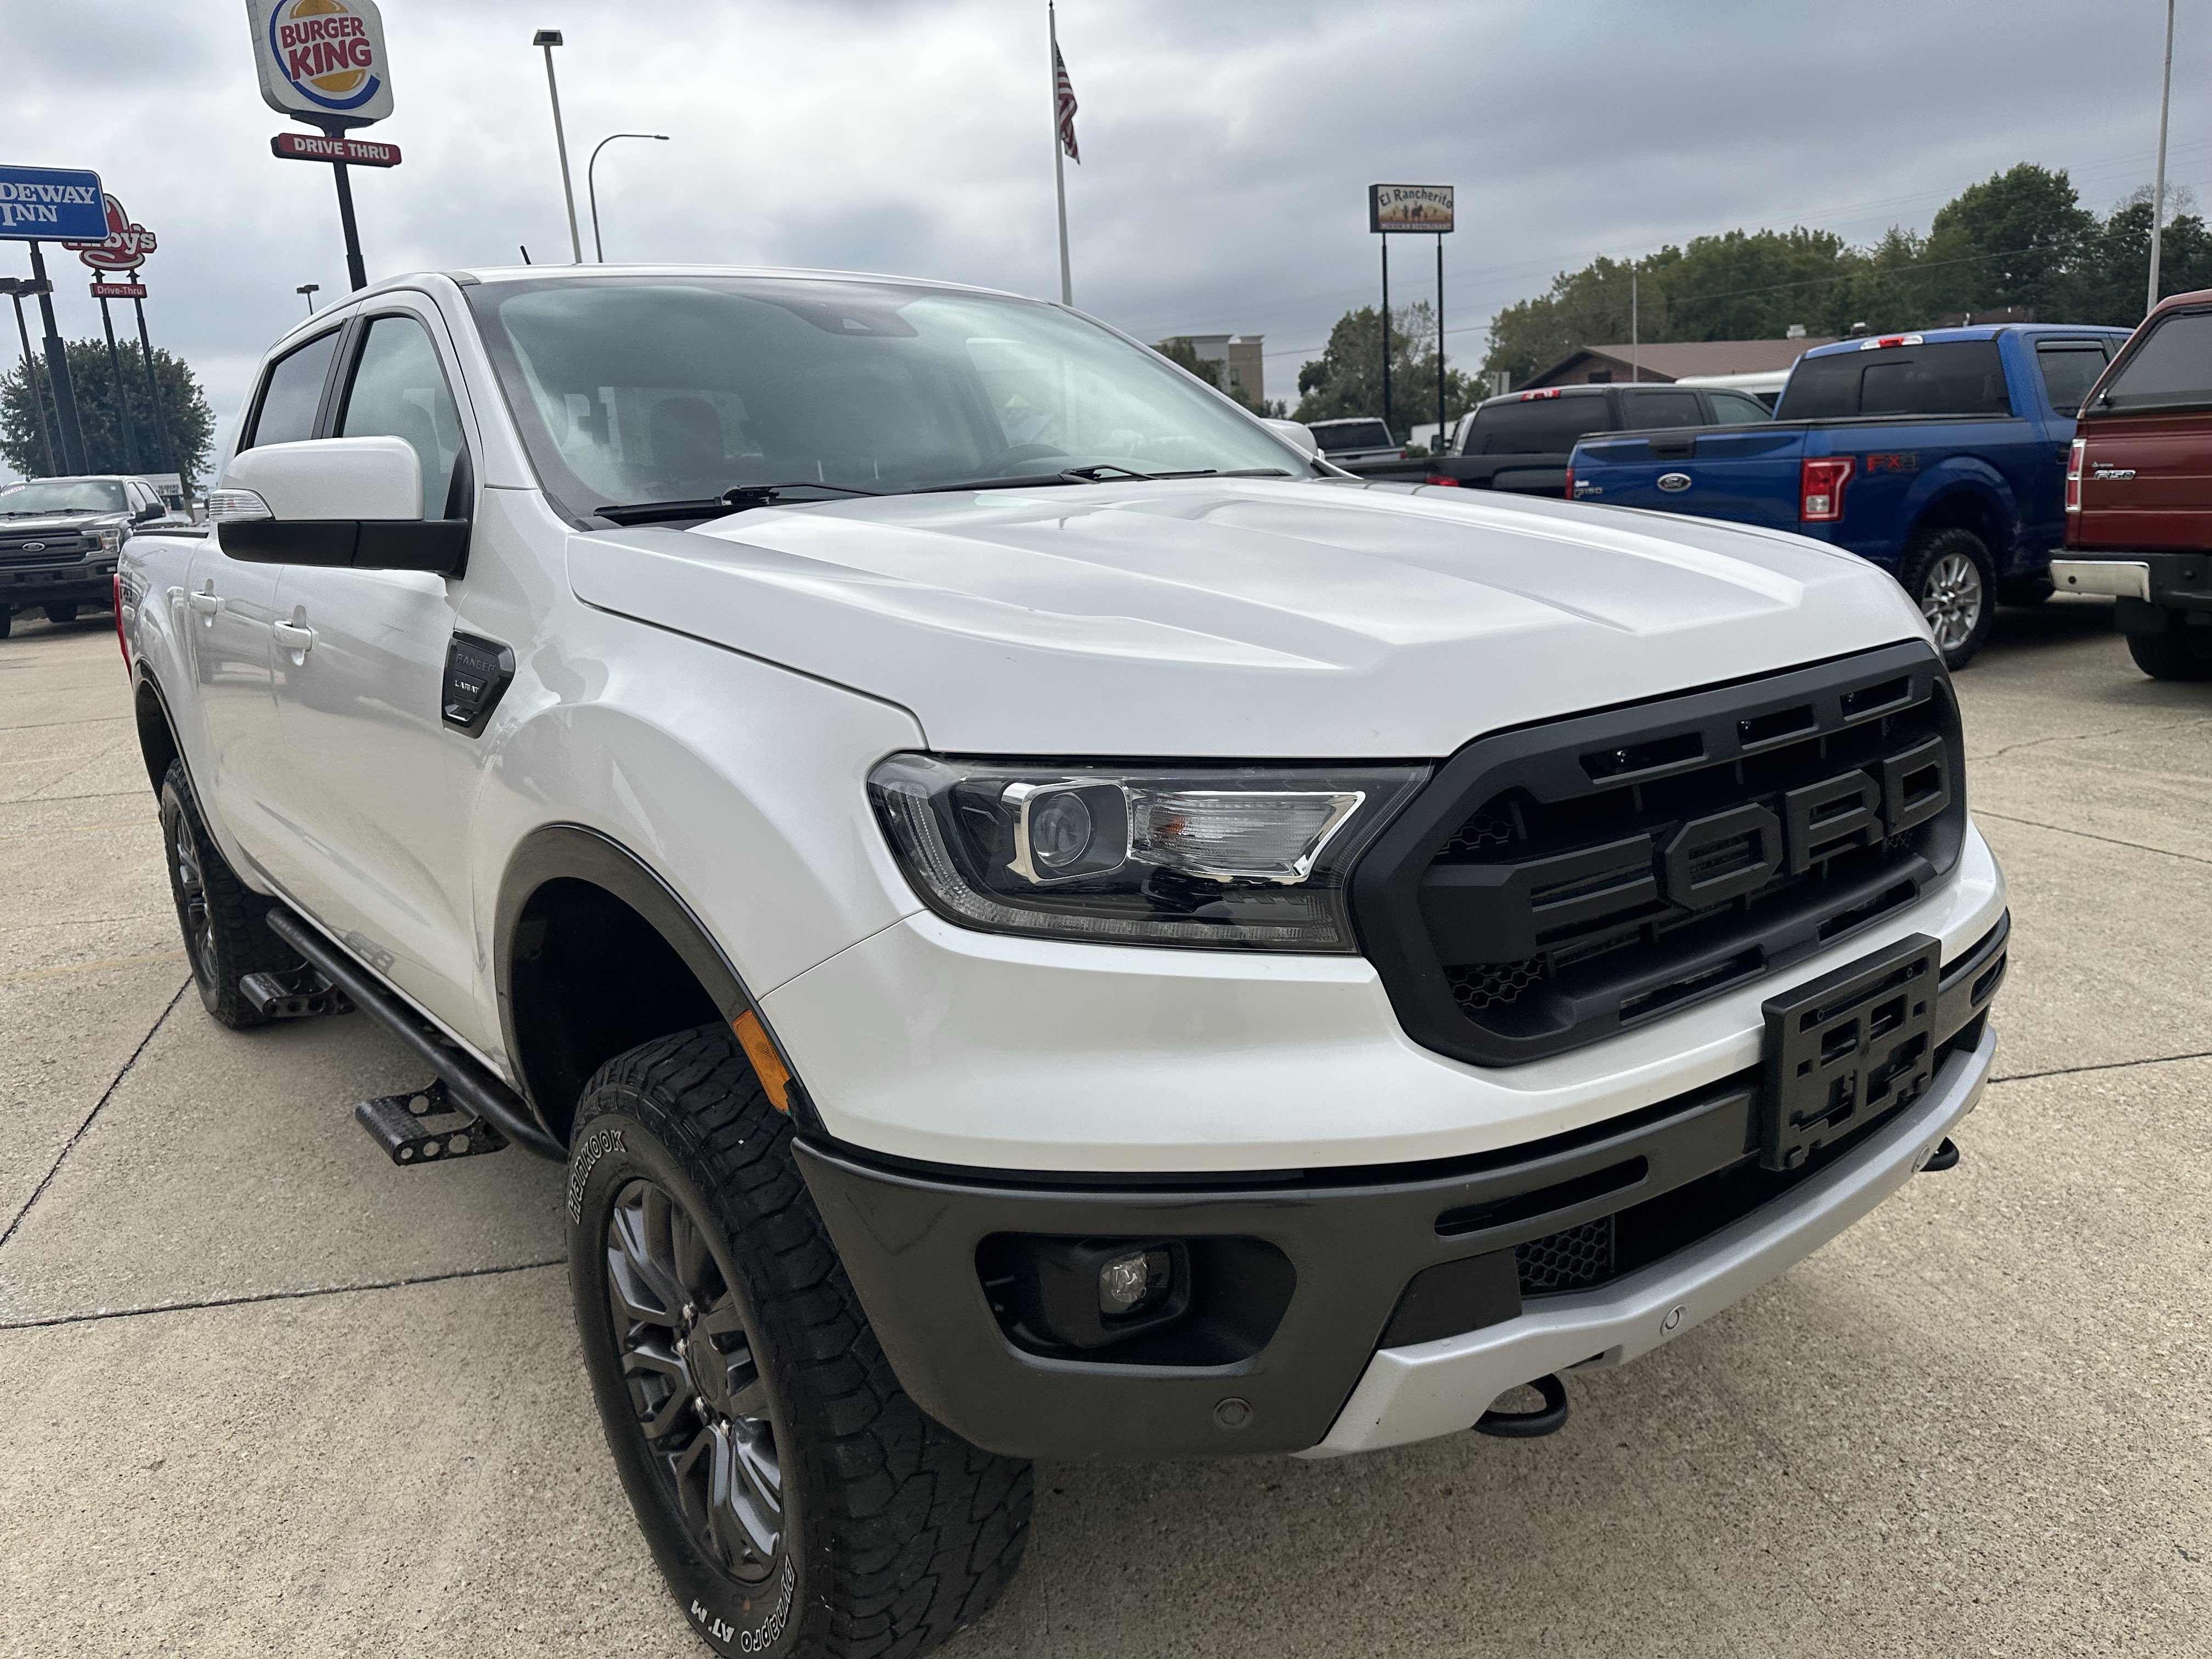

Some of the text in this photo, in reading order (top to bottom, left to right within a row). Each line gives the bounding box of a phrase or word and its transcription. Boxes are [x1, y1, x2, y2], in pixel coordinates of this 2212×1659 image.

[280, 17, 365, 49] BURGER
[289, 38, 373, 80] KING
[294, 138, 390, 160] DRIVE THRU
[1379, 192, 1391, 206] El
[0, 204, 57, 227] INN
[97, 286, 143, 295] Drive-Thru
[1867, 453, 1918, 472] FX4
[456, 653, 496, 672] RANGER
[1421, 734, 1951, 964] FORD
